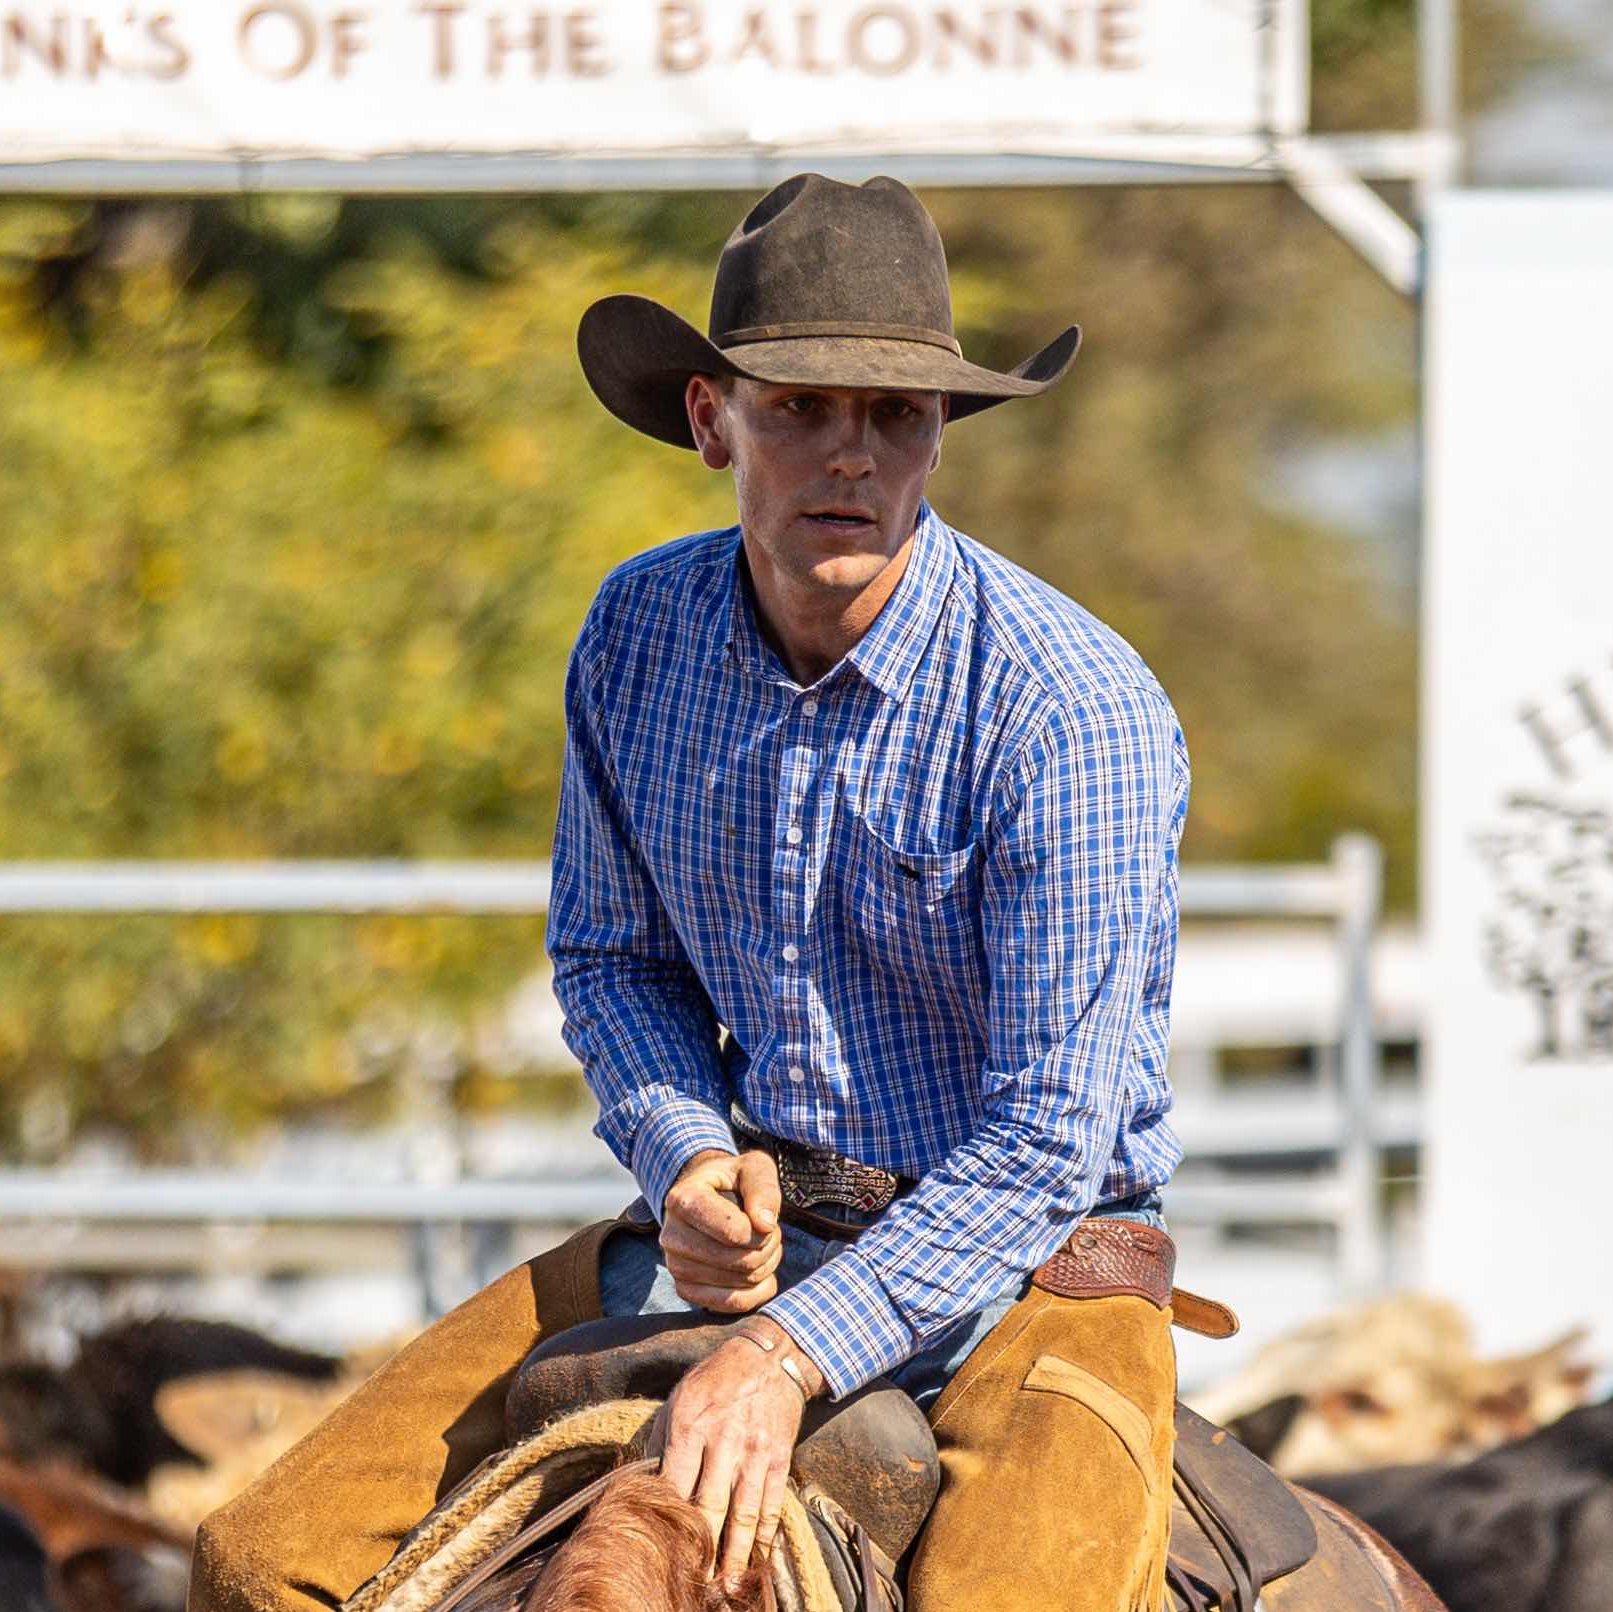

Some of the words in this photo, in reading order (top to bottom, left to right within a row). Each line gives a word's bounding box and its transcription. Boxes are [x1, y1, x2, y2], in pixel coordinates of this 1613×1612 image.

[236, 0, 368, 81] OF
[414, 1, 610, 81] THE
[655, 0, 1143, 78] BALONNE
